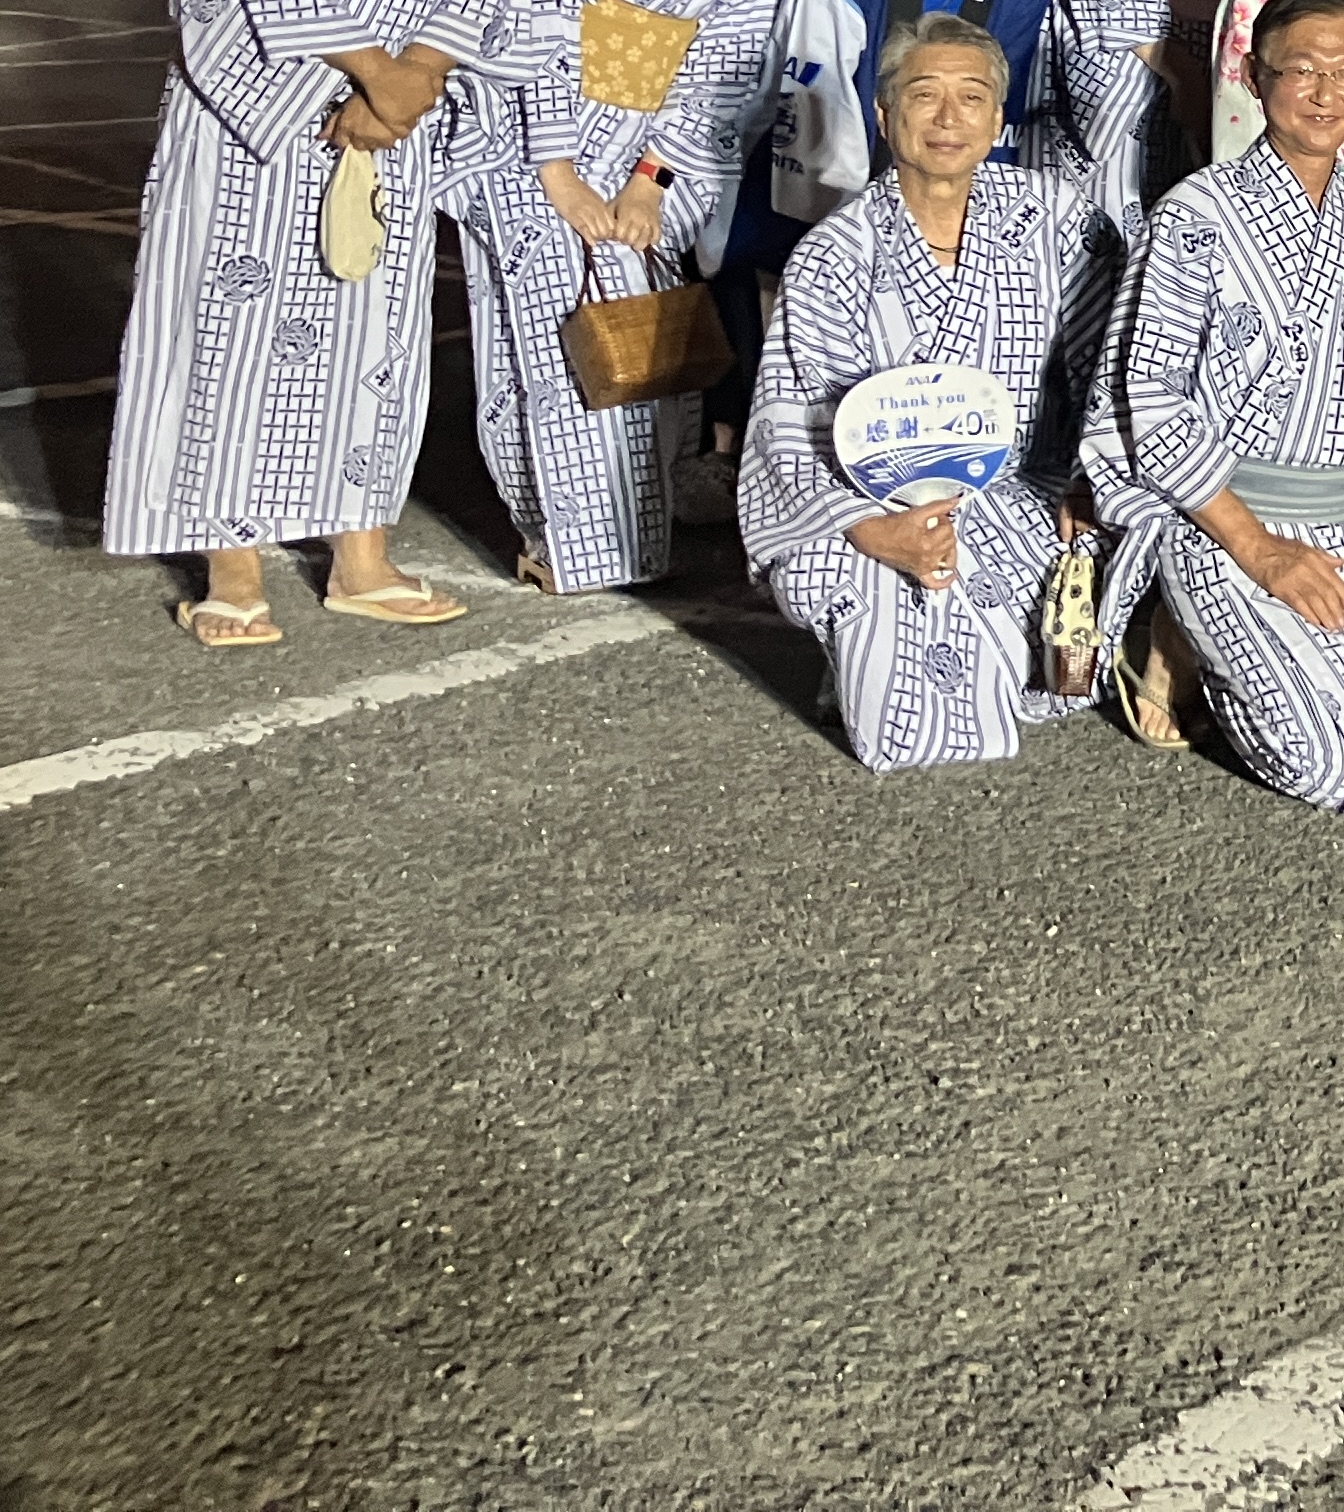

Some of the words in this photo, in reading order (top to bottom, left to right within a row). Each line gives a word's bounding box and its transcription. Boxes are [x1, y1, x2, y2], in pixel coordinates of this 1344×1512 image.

[877, 393, 930, 410] Thank
[937, 393, 966, 408] you
[866, 416, 919, 443] 感謝
